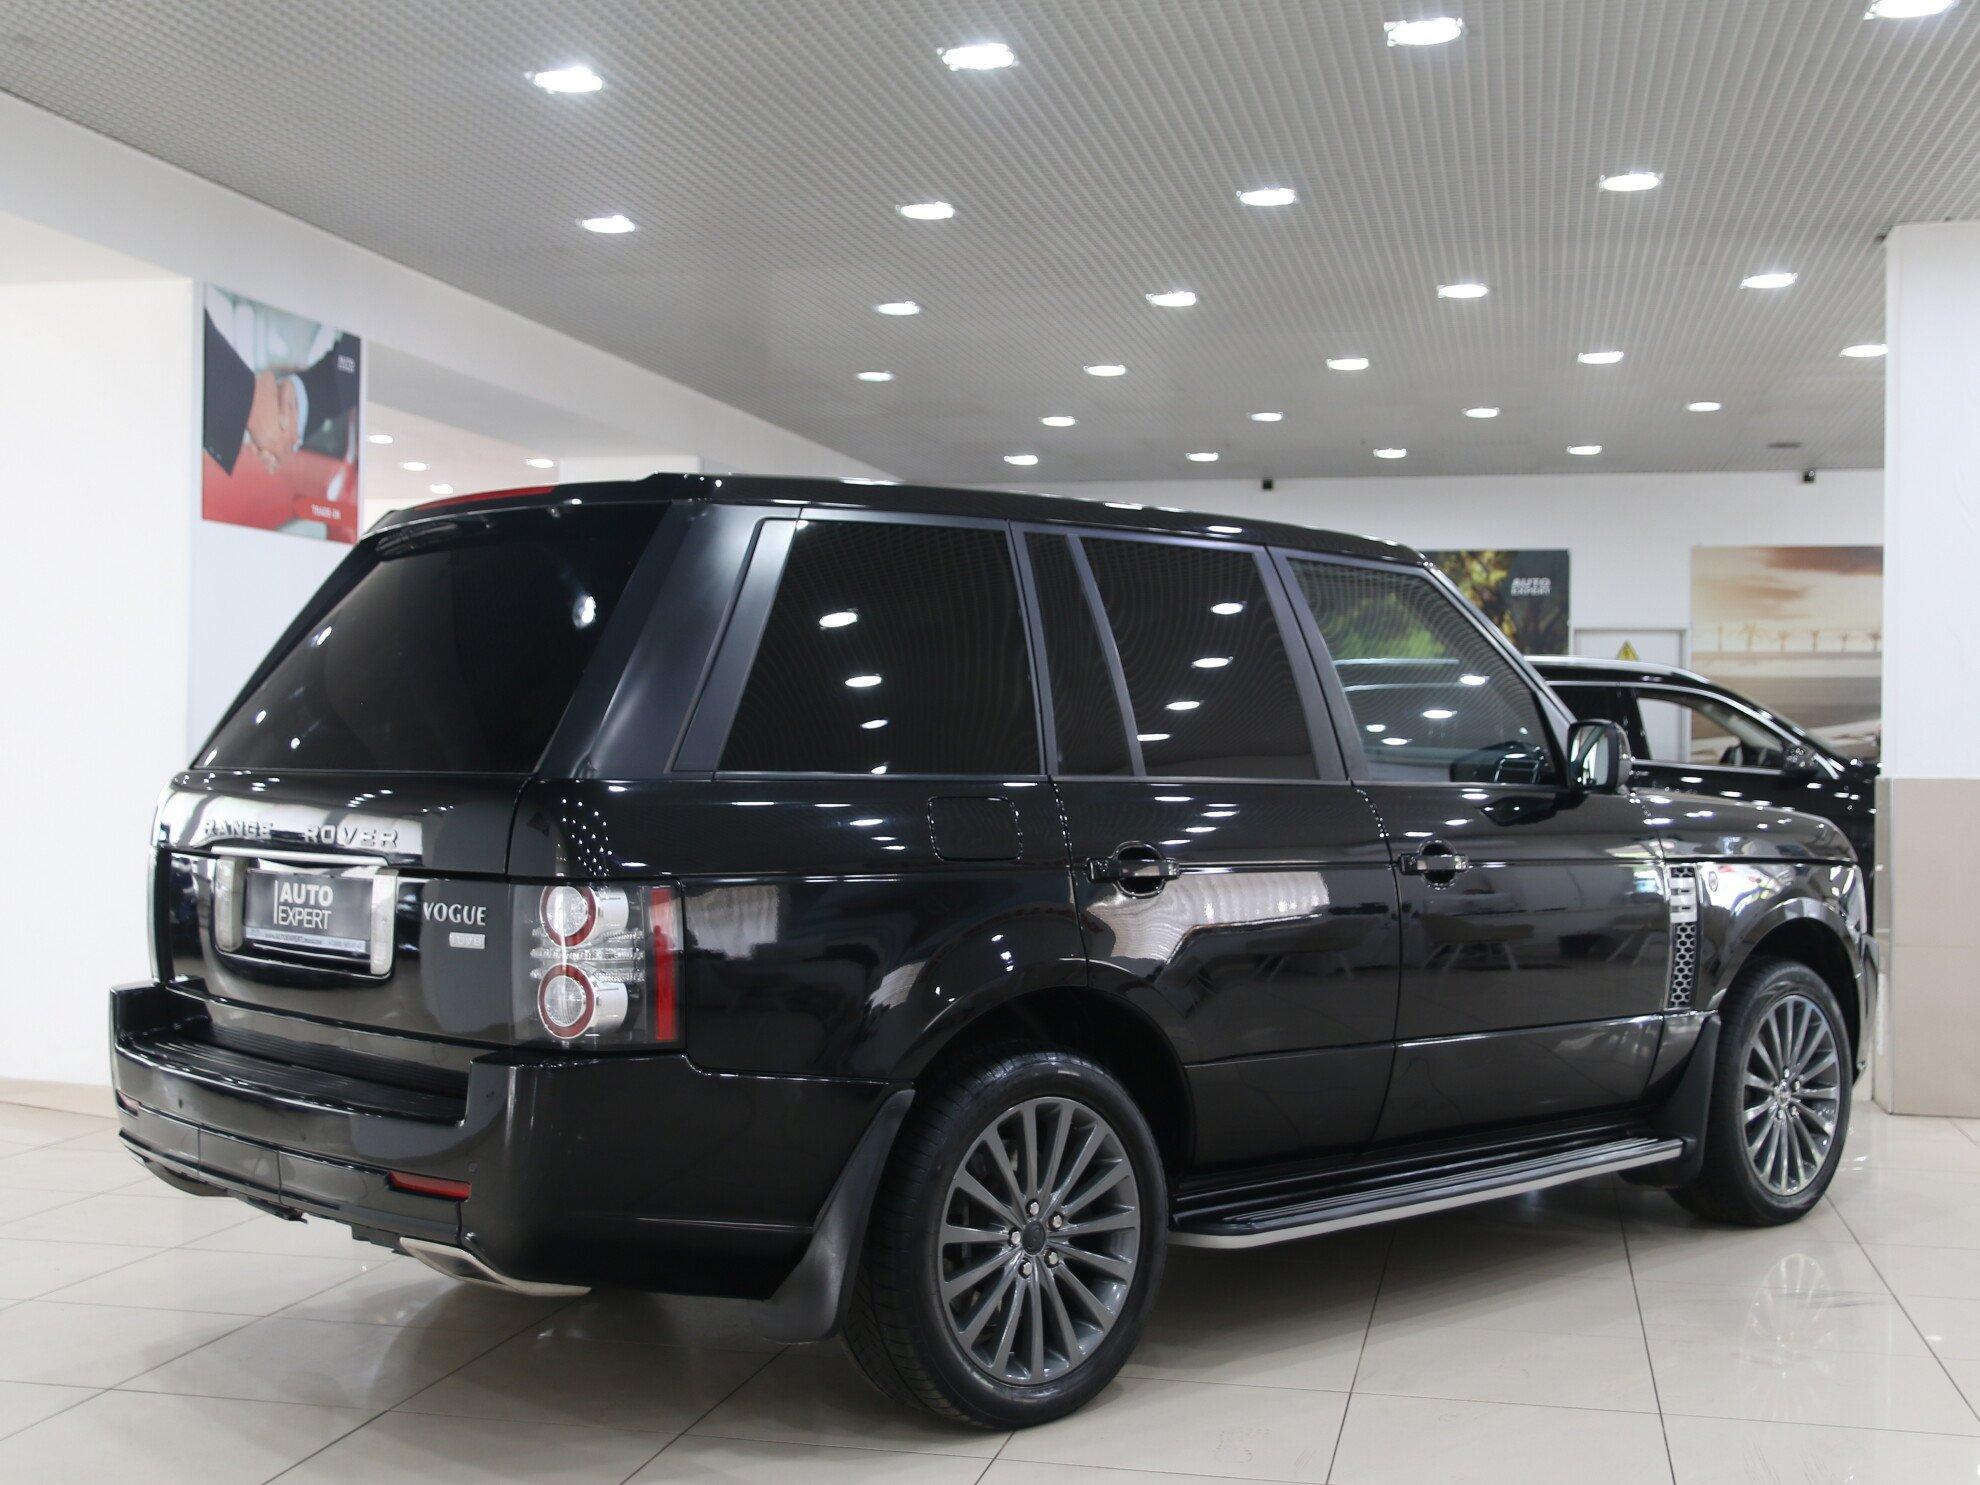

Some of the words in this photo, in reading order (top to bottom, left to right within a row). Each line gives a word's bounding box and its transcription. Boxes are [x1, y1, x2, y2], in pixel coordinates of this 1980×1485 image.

[1511, 577, 1551, 588] AUTO
[204, 818, 274, 840] RANGE
[302, 824, 400, 848] ROVER
[280, 881, 334, 908] AUTO
[279, 905, 333, 930] EXPERT
[422, 901, 487, 926] VOGUE
